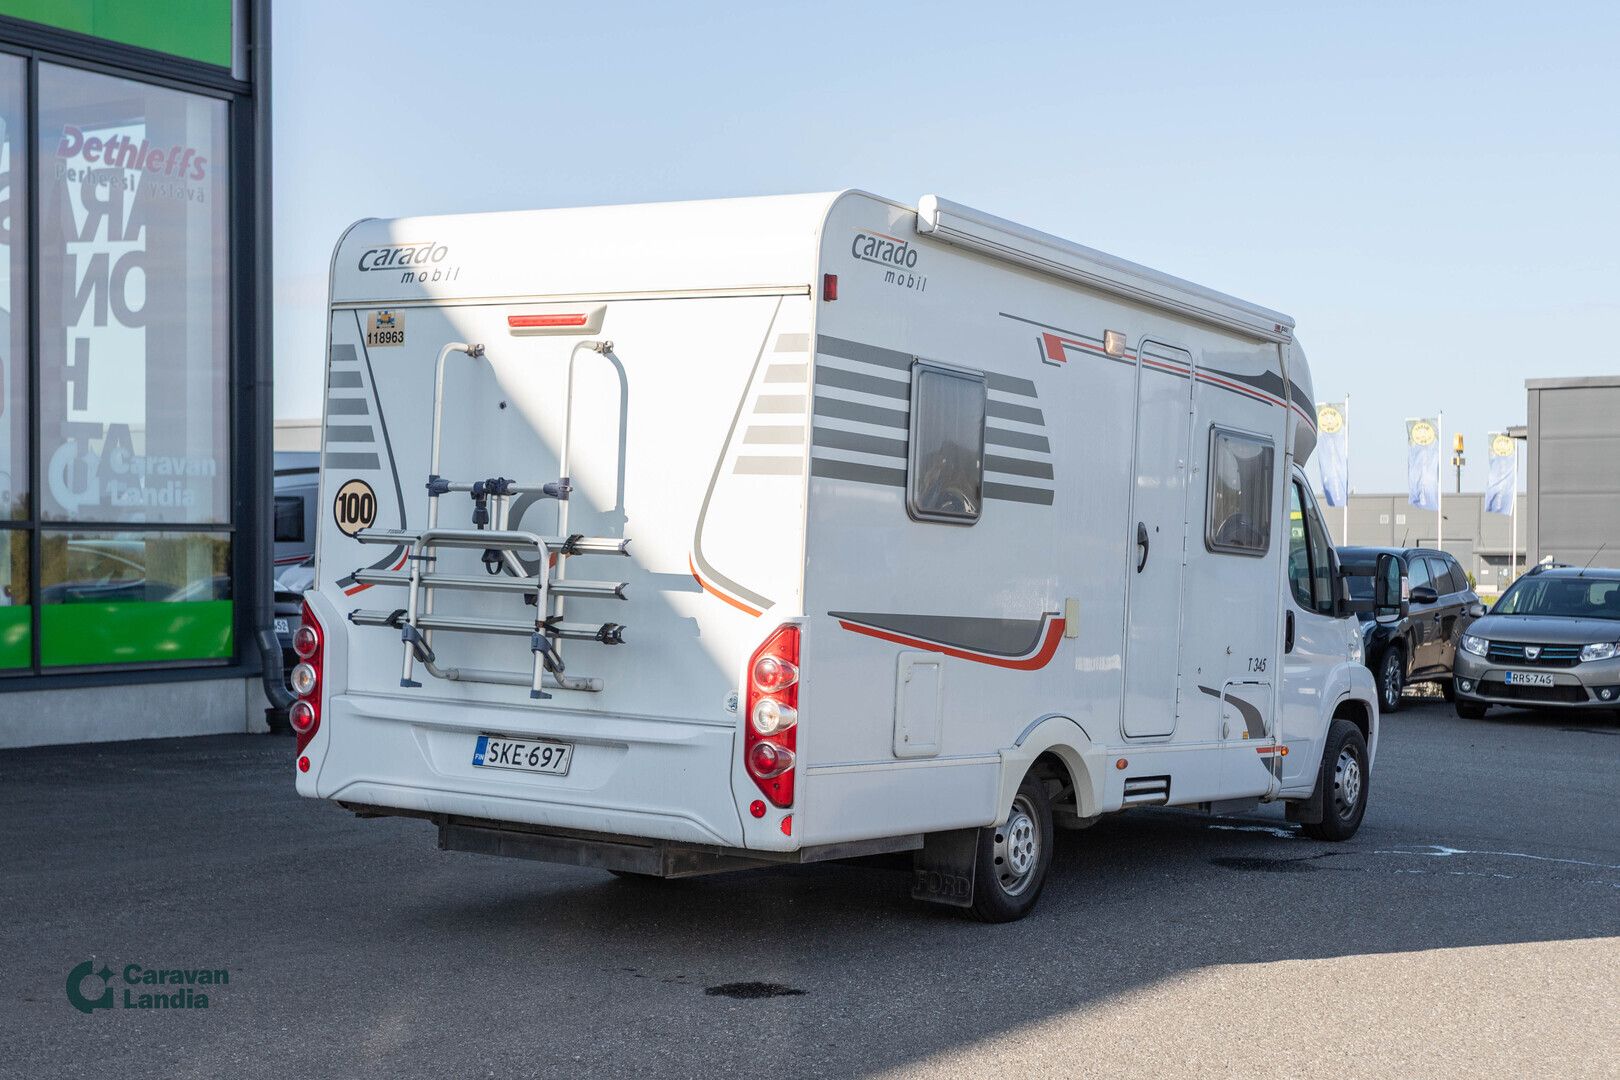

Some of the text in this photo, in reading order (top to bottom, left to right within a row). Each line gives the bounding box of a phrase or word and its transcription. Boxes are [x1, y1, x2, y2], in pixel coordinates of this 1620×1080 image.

[56, 125, 208, 181] Dethleffs
[400, 266, 460, 284] mobil
[884, 270, 927, 292] mobil
[367, 330, 404, 345] 118963
[109, 448, 217, 476] Caravan
[108, 480, 195, 507] Landia
[338, 492, 373, 525] 100
[1253, 657, 1267, 673] 345
[1512, 673, 1552, 685] RRS-746
[488, 742, 566, 769] SKE-697
